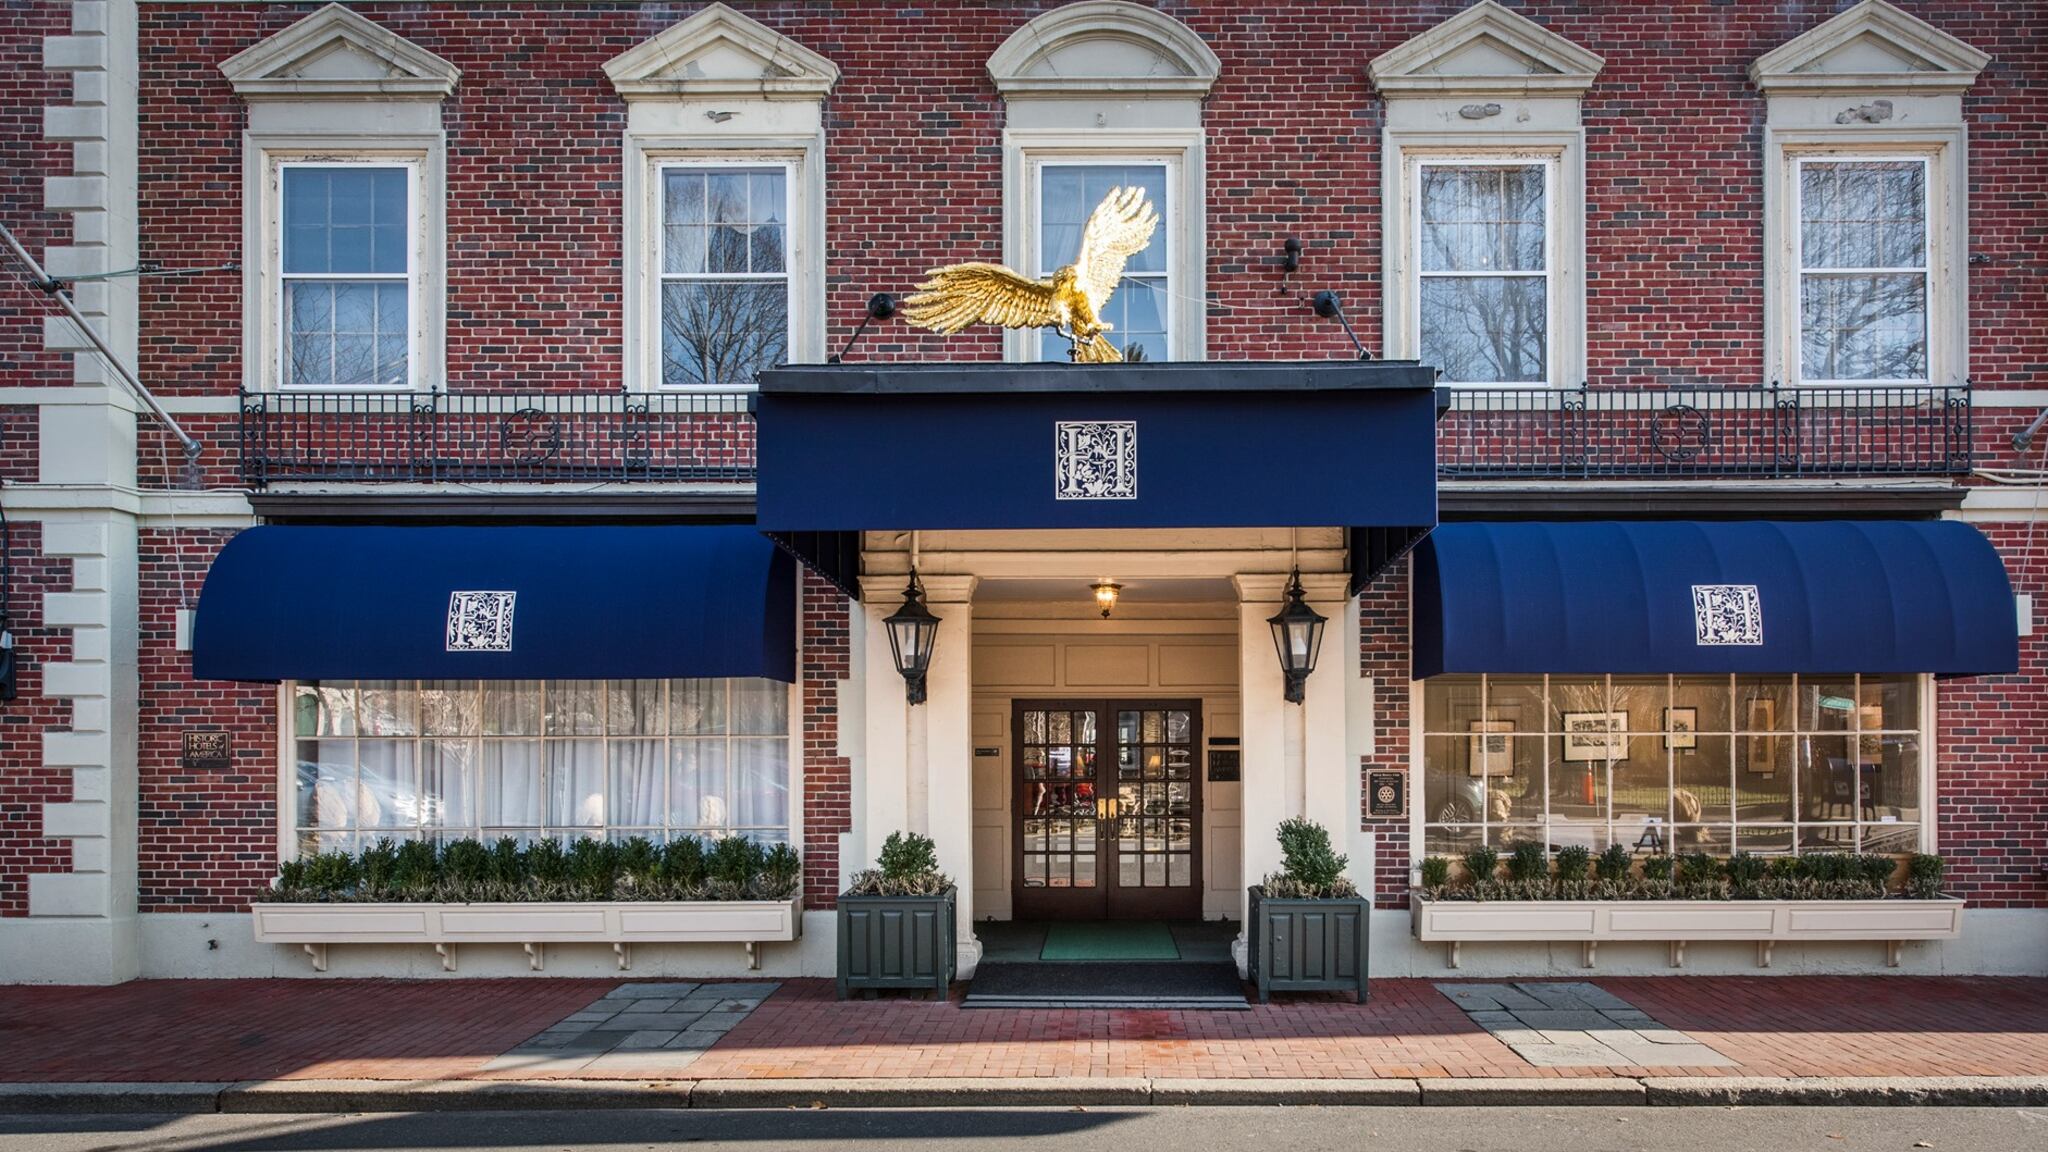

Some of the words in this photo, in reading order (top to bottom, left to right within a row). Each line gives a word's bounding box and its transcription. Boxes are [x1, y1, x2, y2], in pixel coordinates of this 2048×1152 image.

[188, 734, 223, 742] HISTORIC
[188, 742, 217, 750] HOTELS
[189, 750, 222, 758] AMERICA
